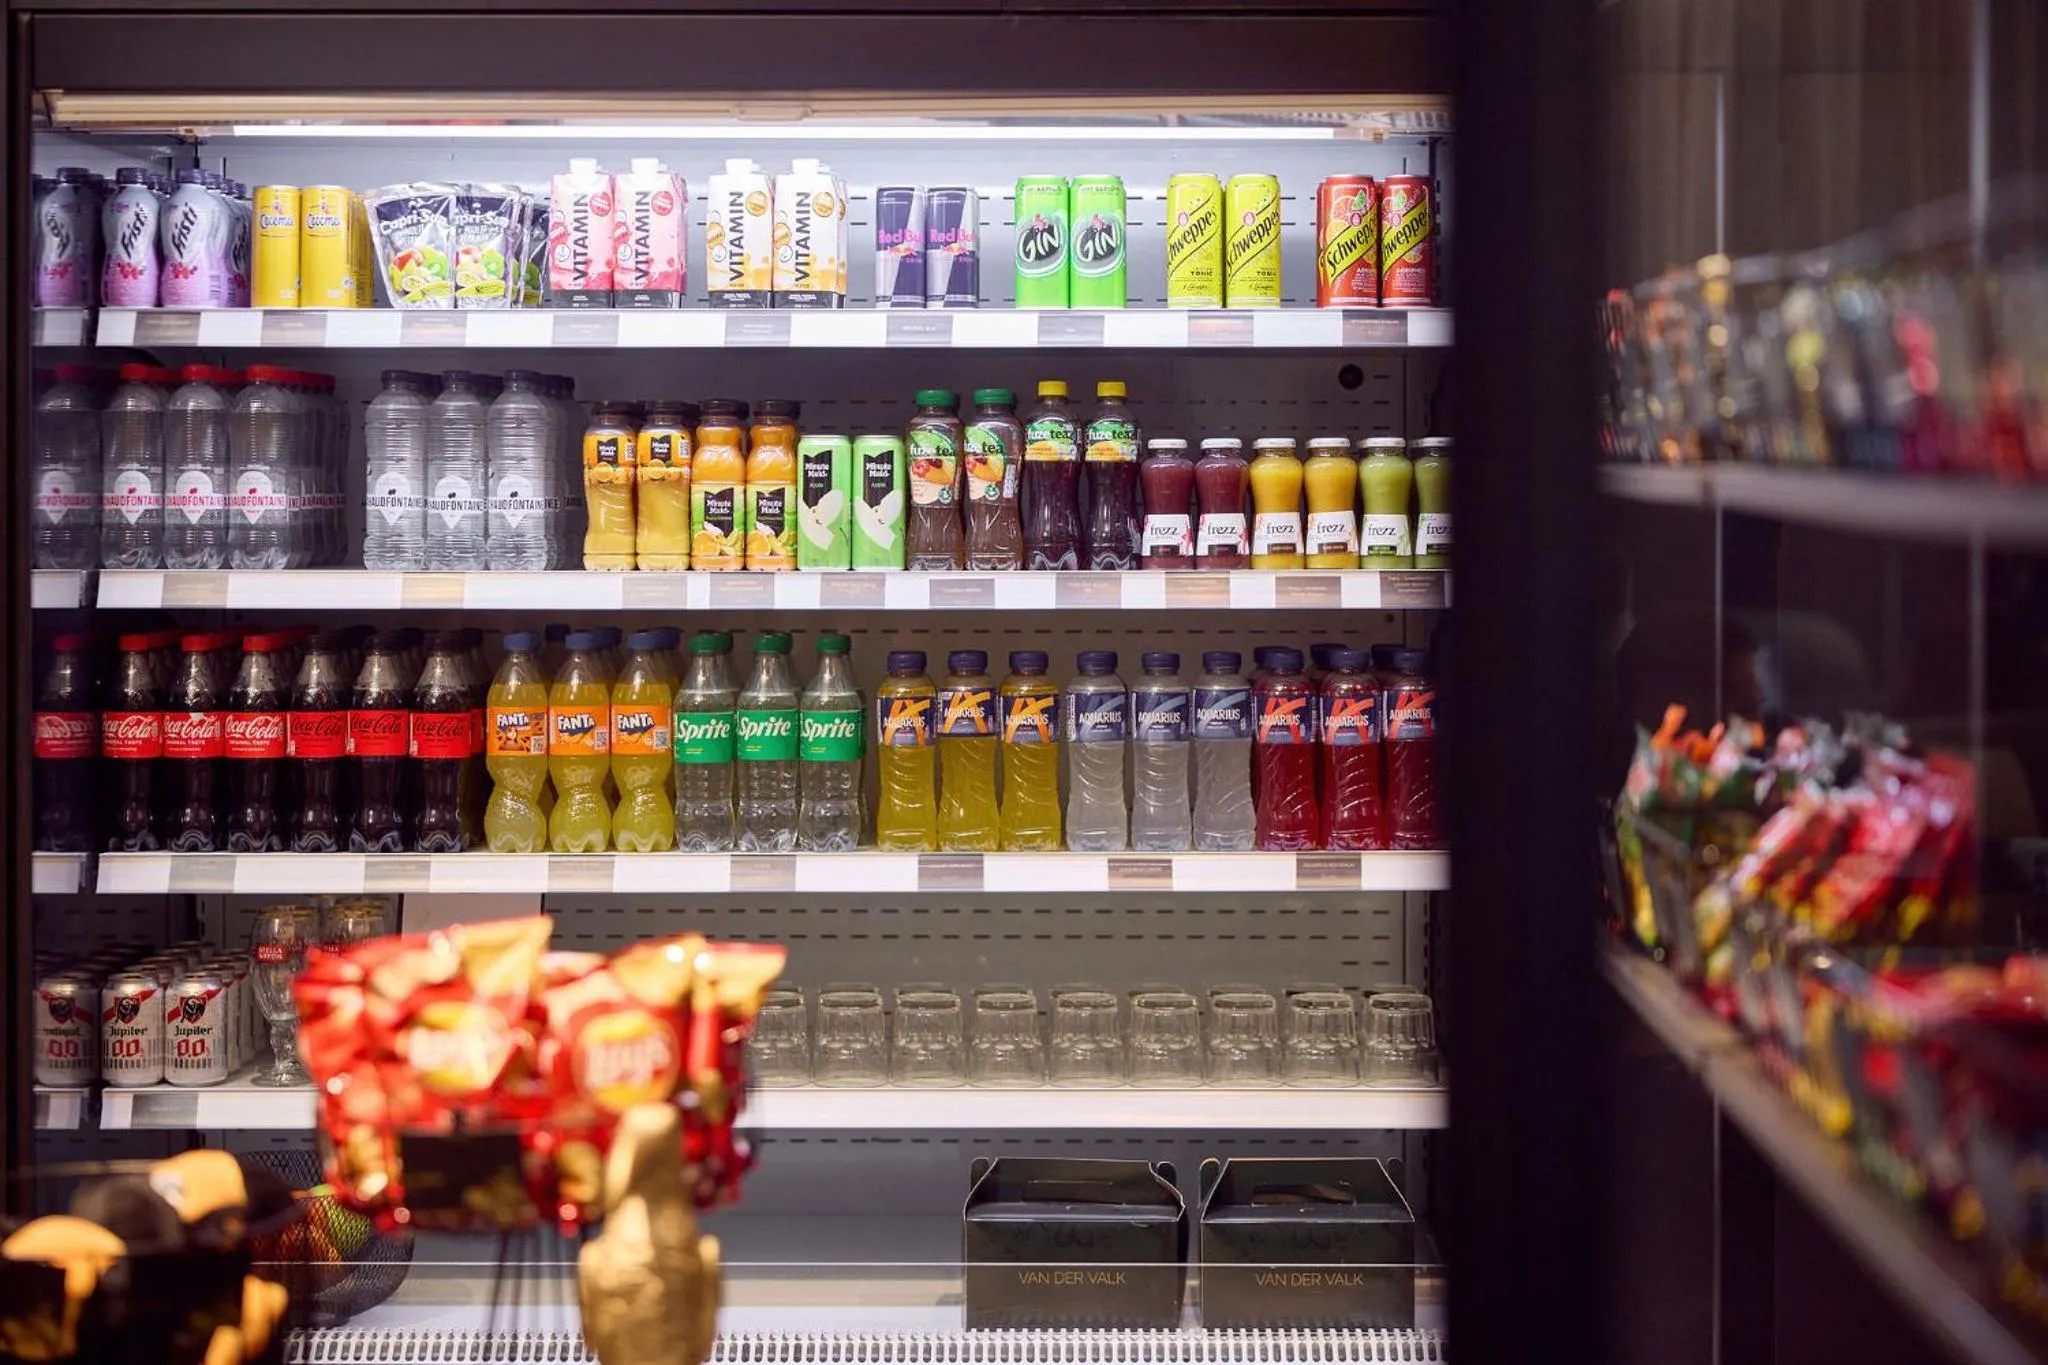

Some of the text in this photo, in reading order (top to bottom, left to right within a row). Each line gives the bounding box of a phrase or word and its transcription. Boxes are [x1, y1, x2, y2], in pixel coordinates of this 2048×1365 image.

[171, 201, 199, 259] Fristi
[573, 193, 589, 281] VITAMIN
[635, 191, 651, 281] VITAMIN
[729, 192, 744, 282] VITAMIN
[795, 192, 811, 282] VITAMIN
[879, 228, 903, 243] Red
[930, 227, 956, 243] Red
[496, 713, 530, 727] FANTA
[944, 707, 985, 718] AQUARIUS
[1079, 711, 1122, 723] AQUARIUS
[1138, 711, 1181, 723] AQUARIUS
[1196, 708, 1241, 720] AQUARIUS
[1258, 714, 1301, 726] AQUARIUS
[1389, 708, 1431, 720] AQUARIUS
[557, 713, 595, 730] FANTA
[617, 713, 654, 729] FANTA
[737, 716, 791, 741] Sprite
[883, 716, 926, 728] AQUARIUS
[1325, 715, 1369, 727] AQUARIUS
[678, 718, 731, 743] Sprite
[801, 717, 856, 742] Sprite
[112, 1039, 140, 1058] 0.0
[177, 1039, 206, 1058] 0.0
[1018, 1271, 1126, 1284] VAN DER VALK
[1255, 1273, 1364, 1286] VAN DER VALK
